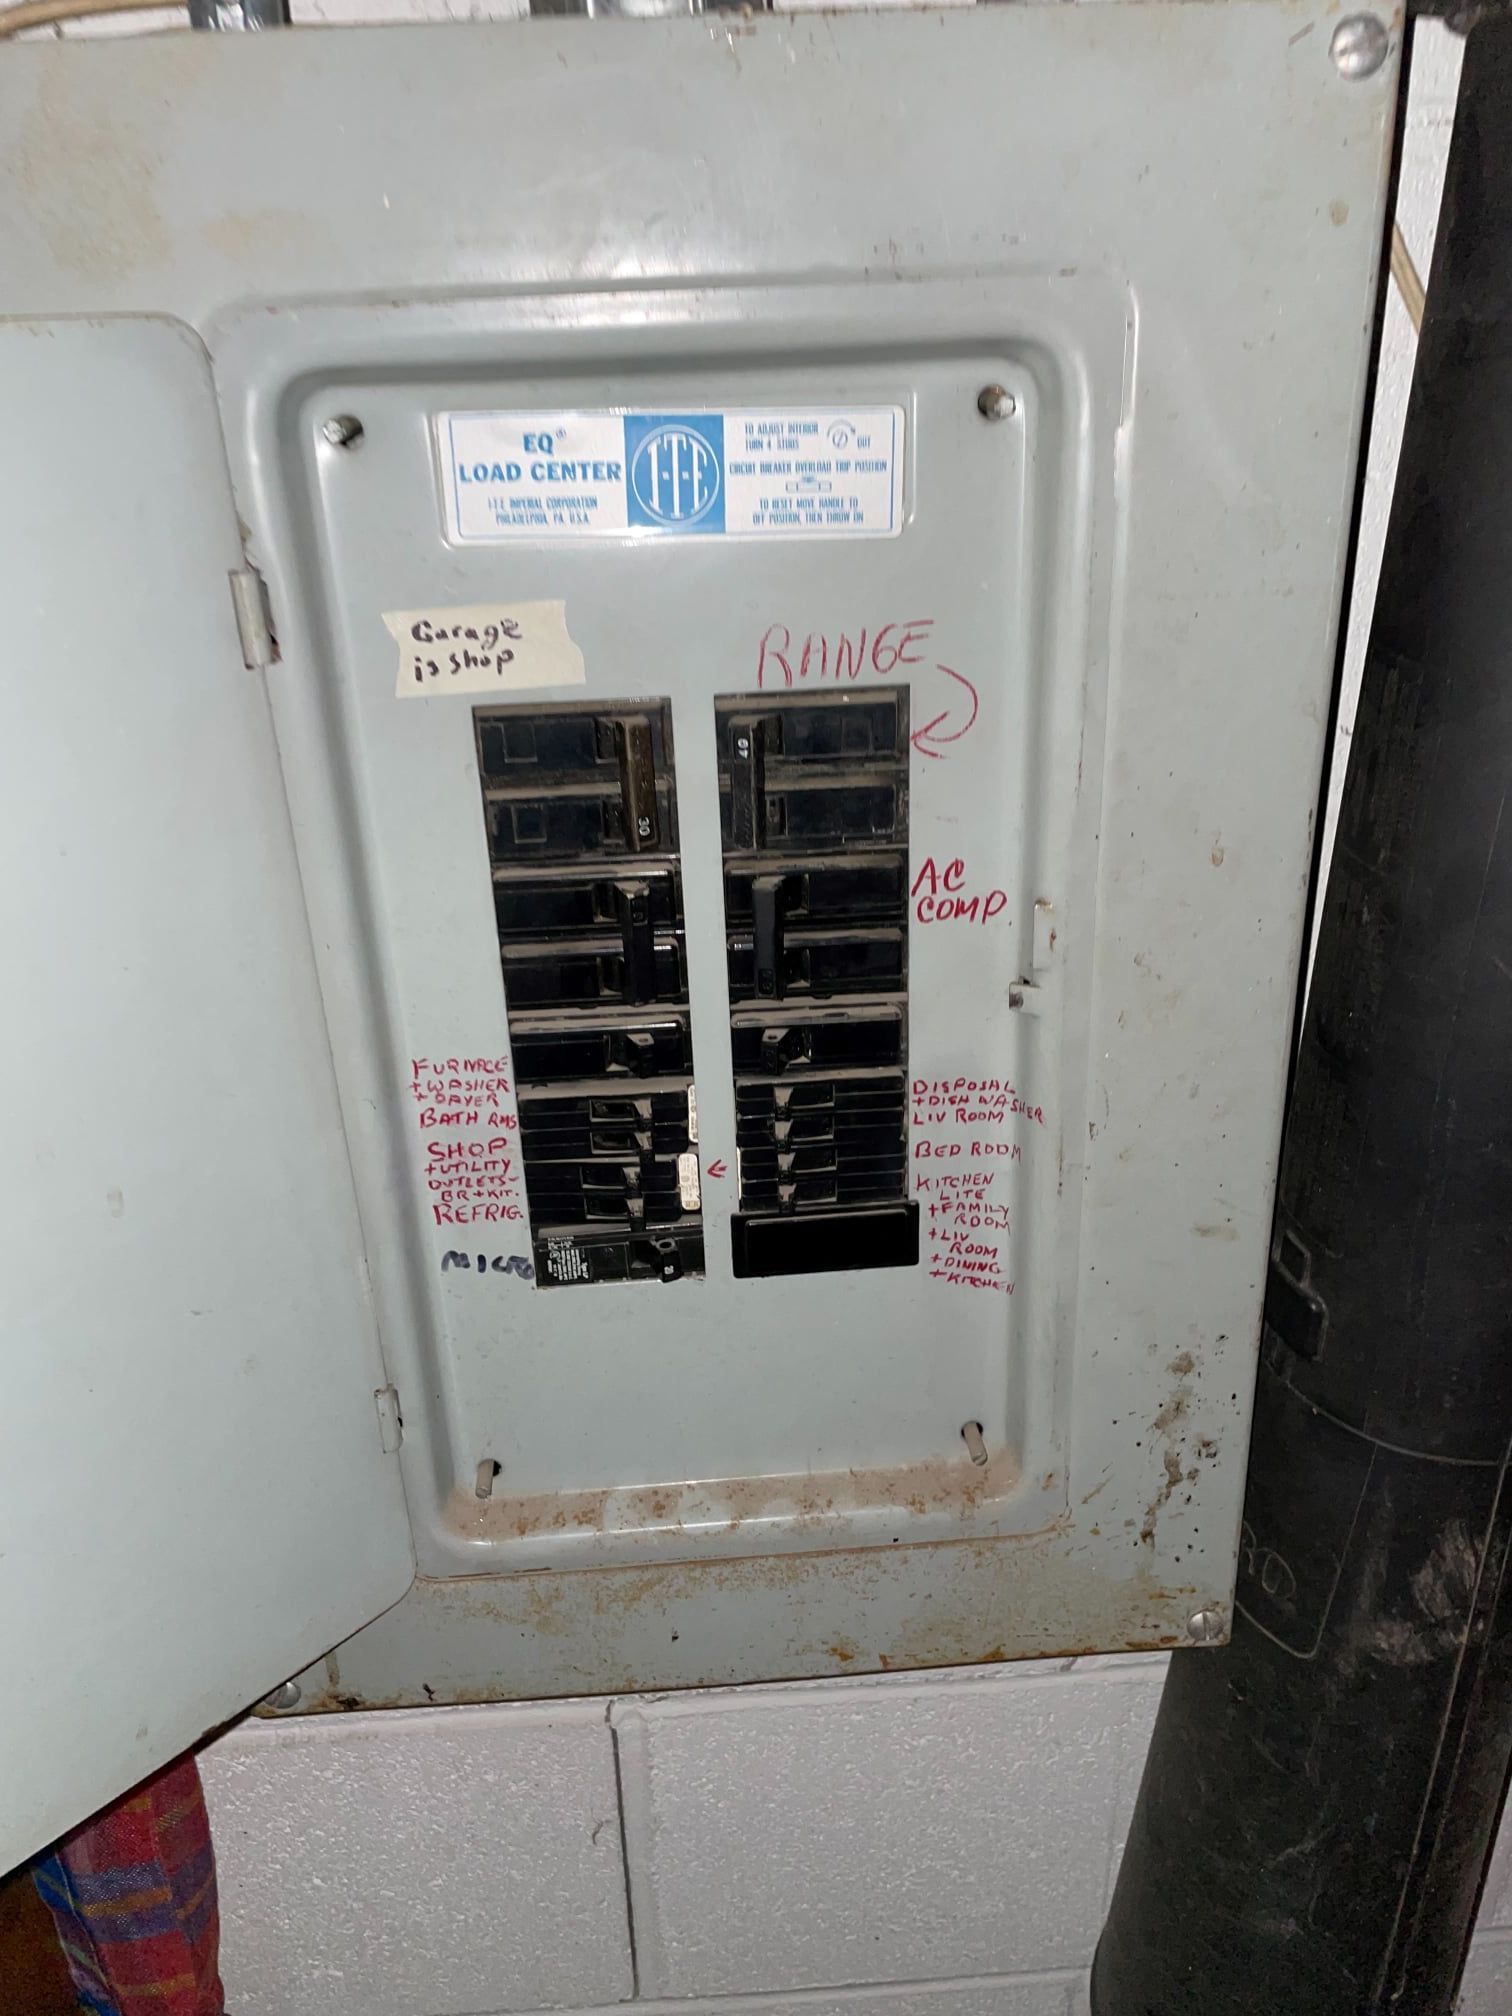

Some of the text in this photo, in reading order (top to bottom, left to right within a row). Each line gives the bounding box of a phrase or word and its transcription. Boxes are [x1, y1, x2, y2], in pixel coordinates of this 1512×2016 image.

[745, 421, 819, 434] TO ADJUST INTERIOR
[745, 438, 763, 451] TURN
[767, 438, 772, 450] 4
[857, 435, 871, 448] OUT
[459, 461, 622, 483] LOAD CENTER
[729, 459, 888, 475] CIRCUIT BREAKER OVERLOAD TRIP POSITION
[546, 495, 598, 509] CORPORATION
[760, 496, 858, 510] TO RESET MOVE HANDLE TO
[753, 513, 764, 525] OFF
[805, 512, 822, 524] THEN
[826, 512, 850, 523] THROW
[853, 511, 864, 523] ON
[757, 620, 934, 688] RANGE
[911, 857, 965, 897] AC
[412, 1056, 508, 1079] FURNACE
[913, 1077, 1015, 1095] DISPOSAL
[420, 1107, 478, 1128] BATH
[914, 1108, 1004, 1125] LIV ROOM
[427, 1137, 507, 1162] SHOP
[915, 1141, 1021, 1161] BED ROOM
[916, 1173, 994, 1191] KITCHEN
[940, 1189, 985, 1201] LITE
[954, 1213, 1010, 1236] ROOM
[950, 1242, 998, 1259] ROOM
